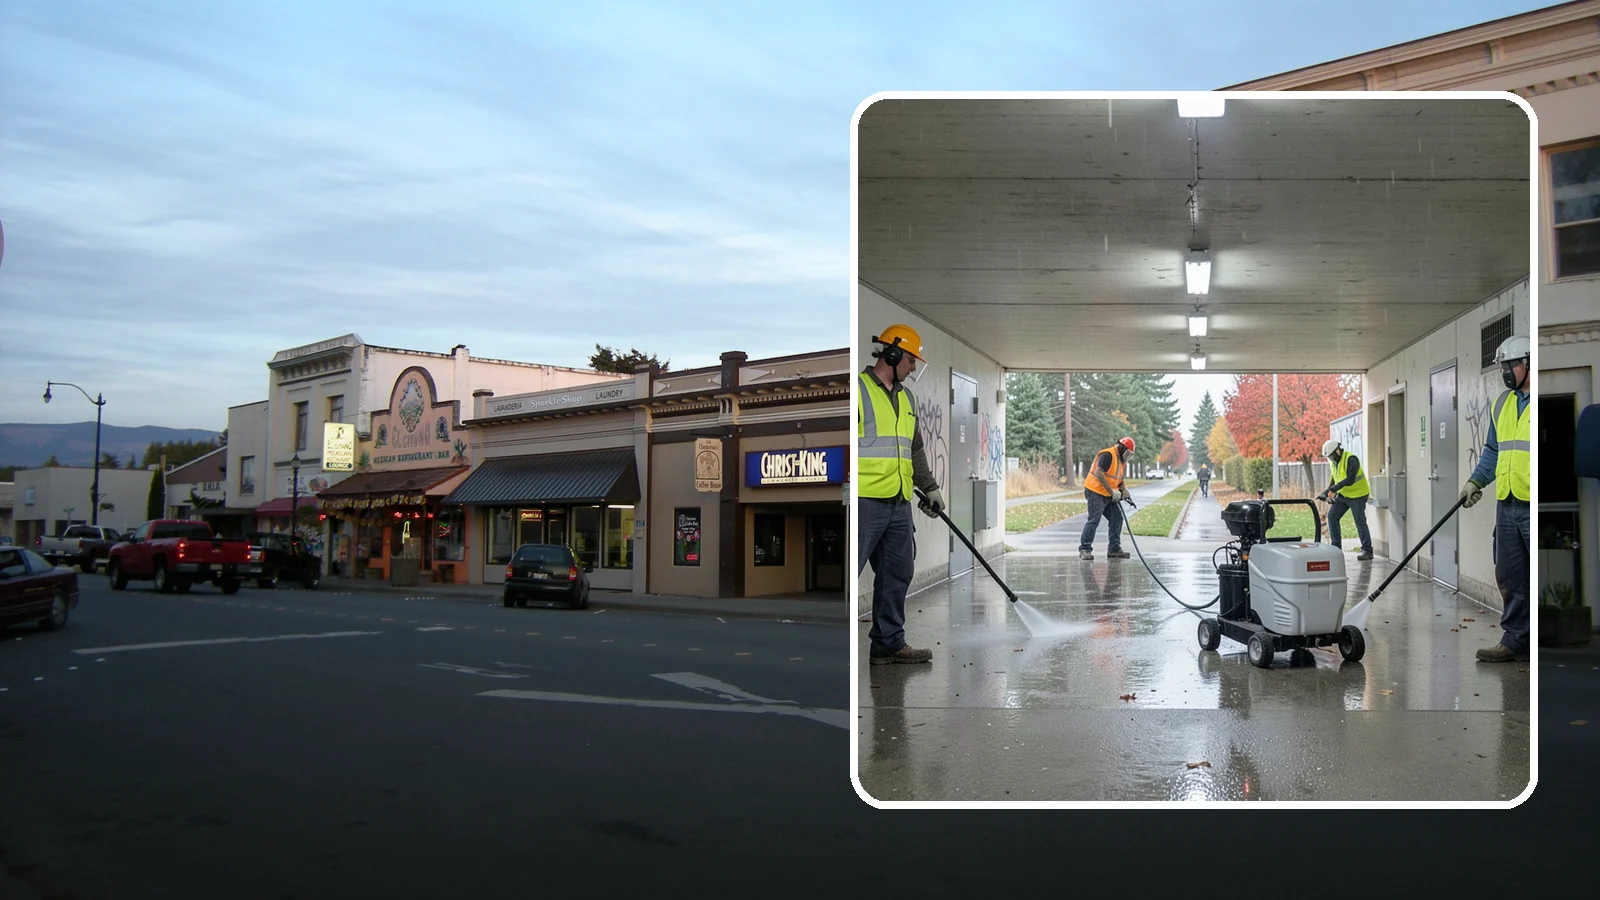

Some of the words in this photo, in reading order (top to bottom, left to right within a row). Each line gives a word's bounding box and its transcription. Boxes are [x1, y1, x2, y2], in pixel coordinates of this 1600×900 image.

[562, 394, 583, 405] Shop
[595, 389, 624, 400] LAUNDRY
[493, 402, 523, 413] LAVANDERIA
[397, 451, 433, 462] RESTAURANT
[438, 450, 450, 459] BAR
[761, 452, 798, 478] CHRIST
[799, 450, 827, 476] KING
